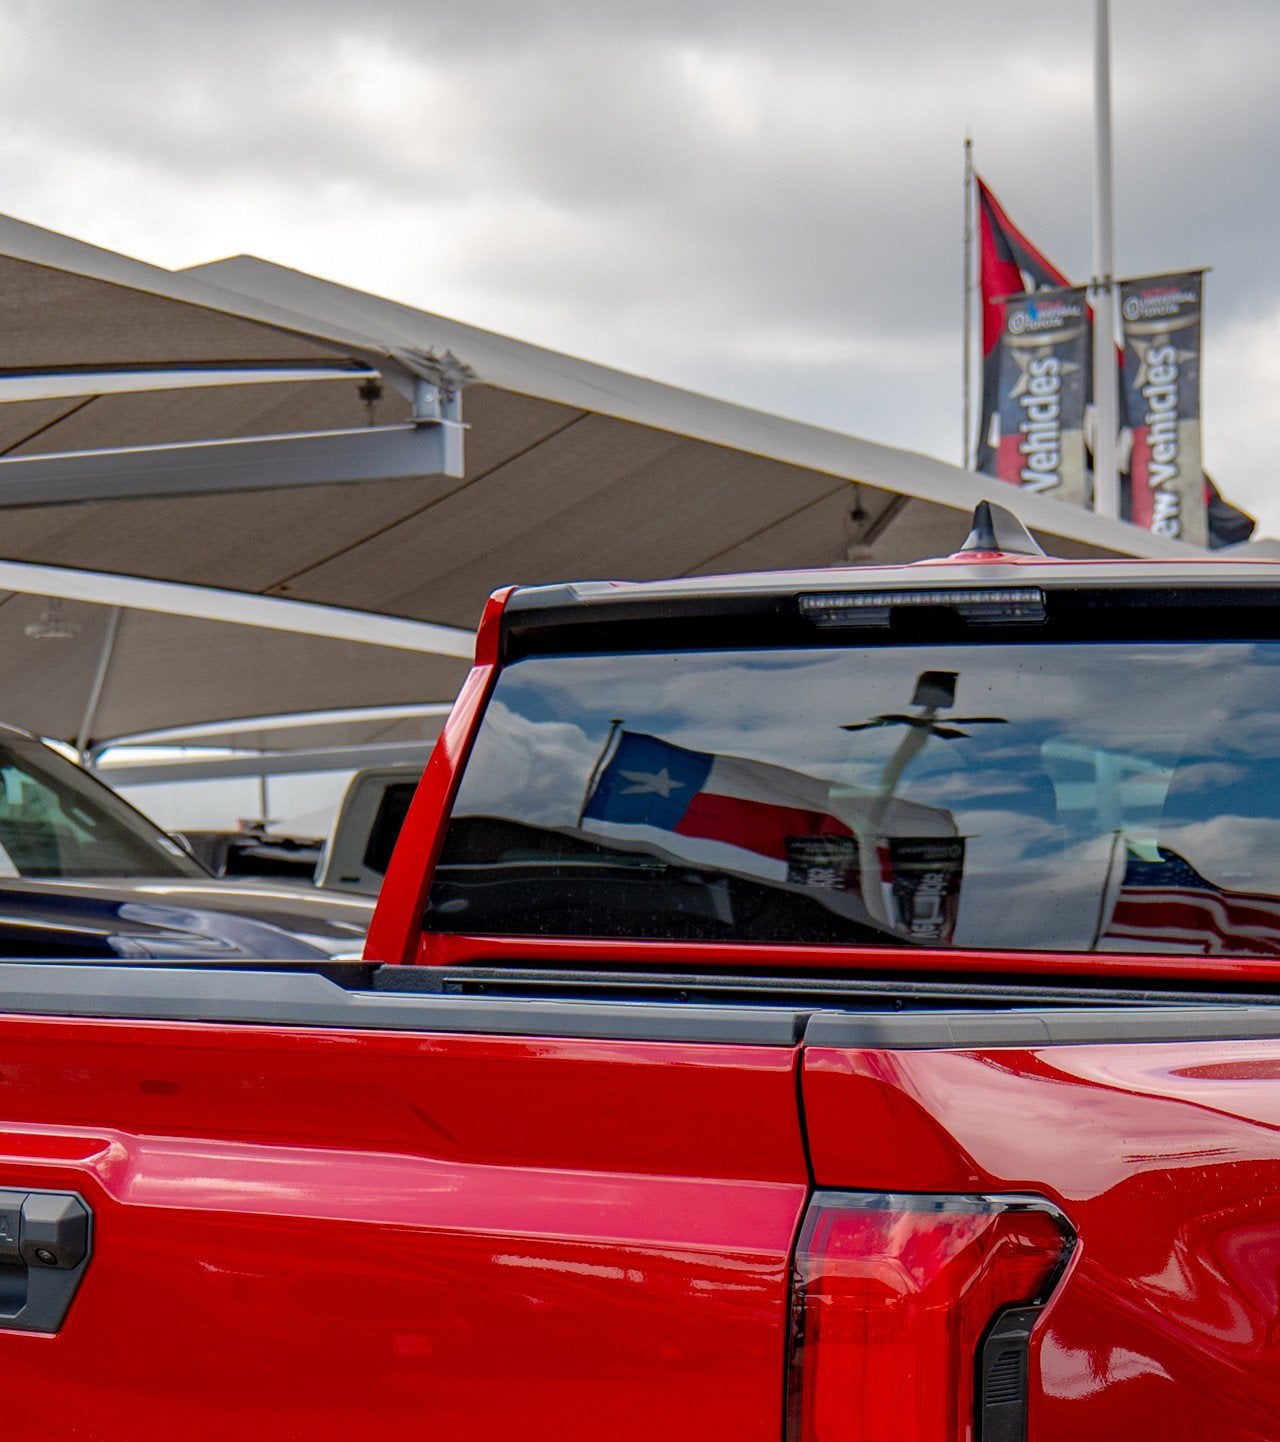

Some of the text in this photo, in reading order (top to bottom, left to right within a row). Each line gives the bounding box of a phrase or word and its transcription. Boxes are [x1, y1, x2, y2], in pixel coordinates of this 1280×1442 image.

[1020, 357, 1061, 492] Vehicles
[1144, 345, 1182, 538] ew Vehicles
